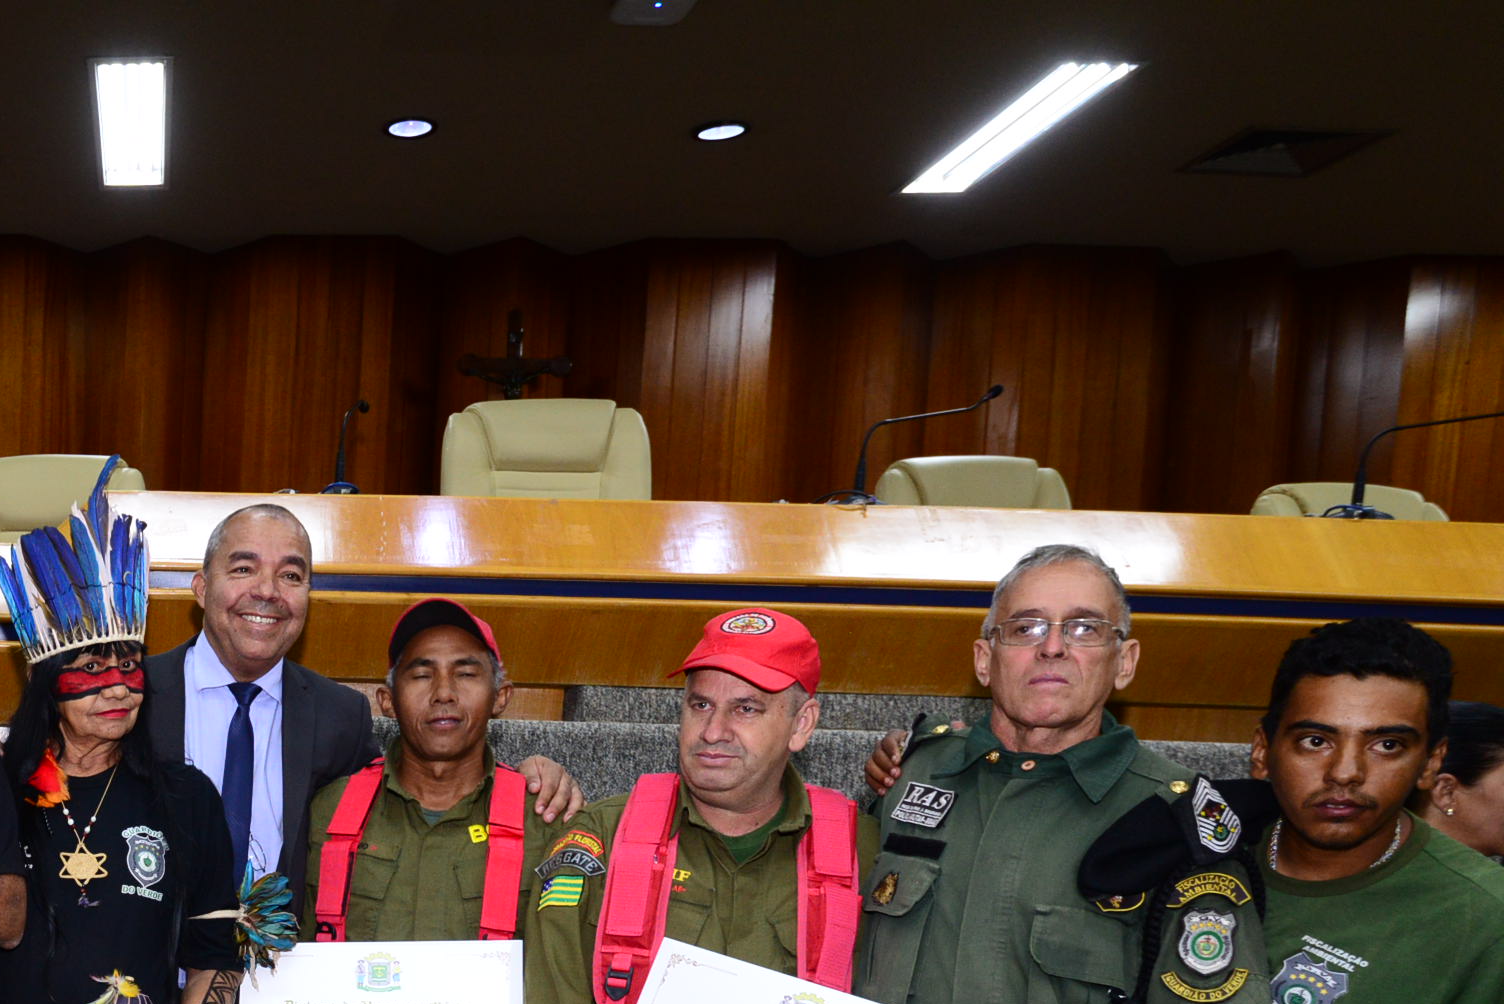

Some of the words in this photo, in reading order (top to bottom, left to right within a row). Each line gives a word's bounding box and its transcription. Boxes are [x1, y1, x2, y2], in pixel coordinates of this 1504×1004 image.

[904, 786, 952, 809] RAS
[122, 826, 169, 851] GUARDIÕ
[121, 885, 135, 894] DO
[137, 887, 163, 901] VERDE
[1179, 884, 1237, 903] AMBIENTAL
[1302, 945, 1355, 972] AMBIENTAL
[1209, 991, 1222, 999] DO
[1223, 970, 1247, 995] VERDE
